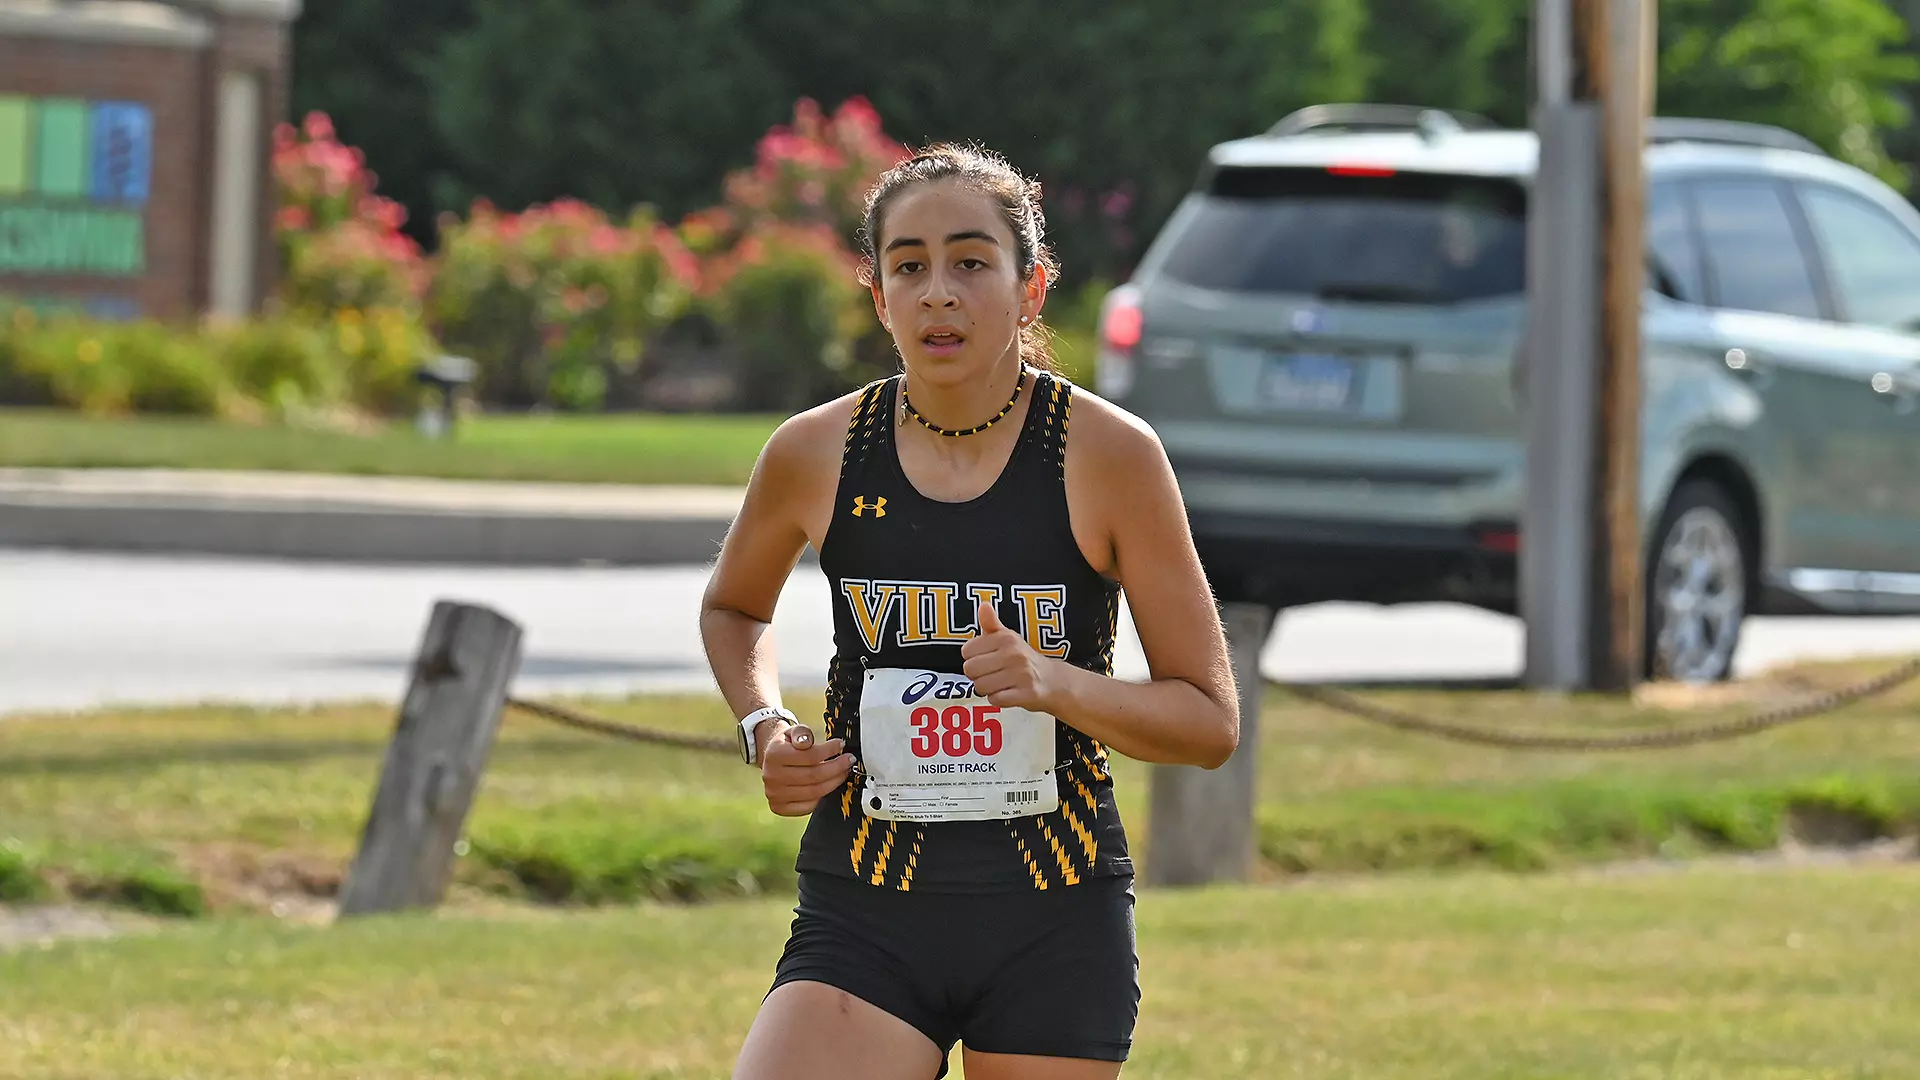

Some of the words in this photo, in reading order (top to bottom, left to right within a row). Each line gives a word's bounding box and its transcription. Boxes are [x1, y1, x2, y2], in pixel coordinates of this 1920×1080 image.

[935, 681, 987, 699] asi
[910, 706, 1003, 758] 385
[918, 764, 955, 774] INSIDE
[957, 762, 997, 773] TRACK
